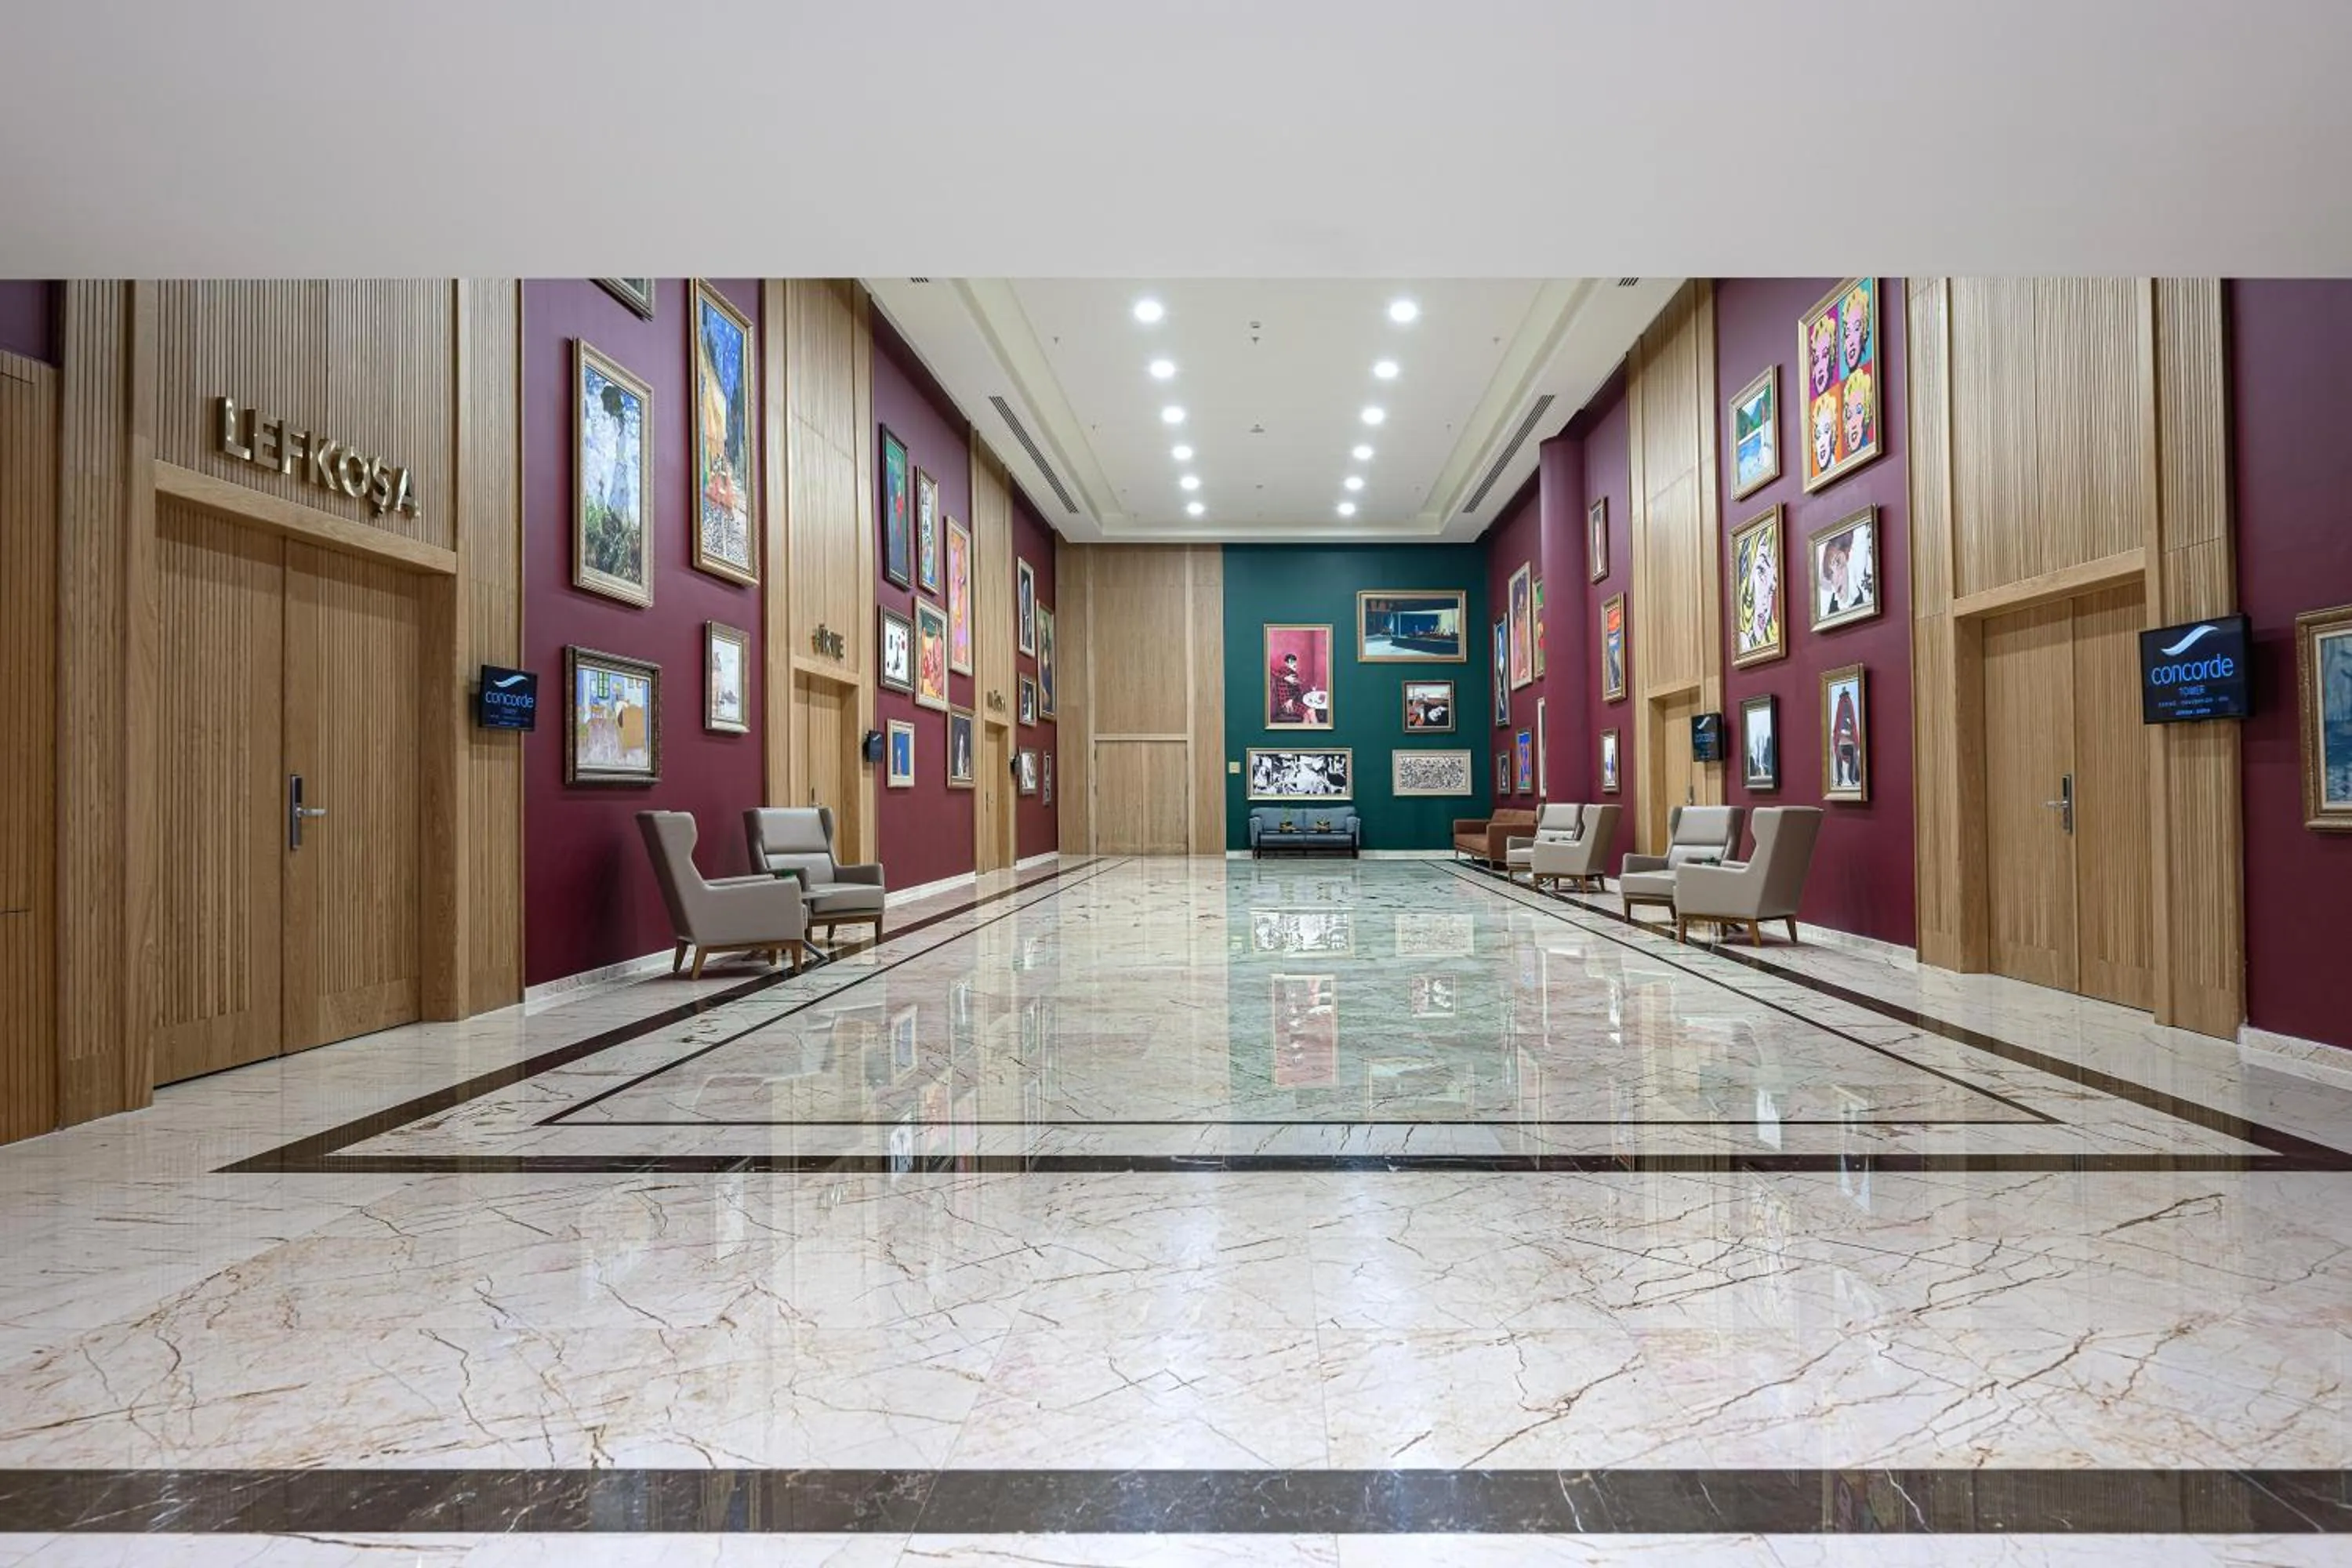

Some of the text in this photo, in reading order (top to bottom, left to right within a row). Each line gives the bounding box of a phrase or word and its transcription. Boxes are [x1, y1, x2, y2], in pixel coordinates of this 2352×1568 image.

[216, 397, 421, 518] LEFKOŞA
[2151, 654, 2234, 685] concorde
[485, 691, 534, 708] concorde
